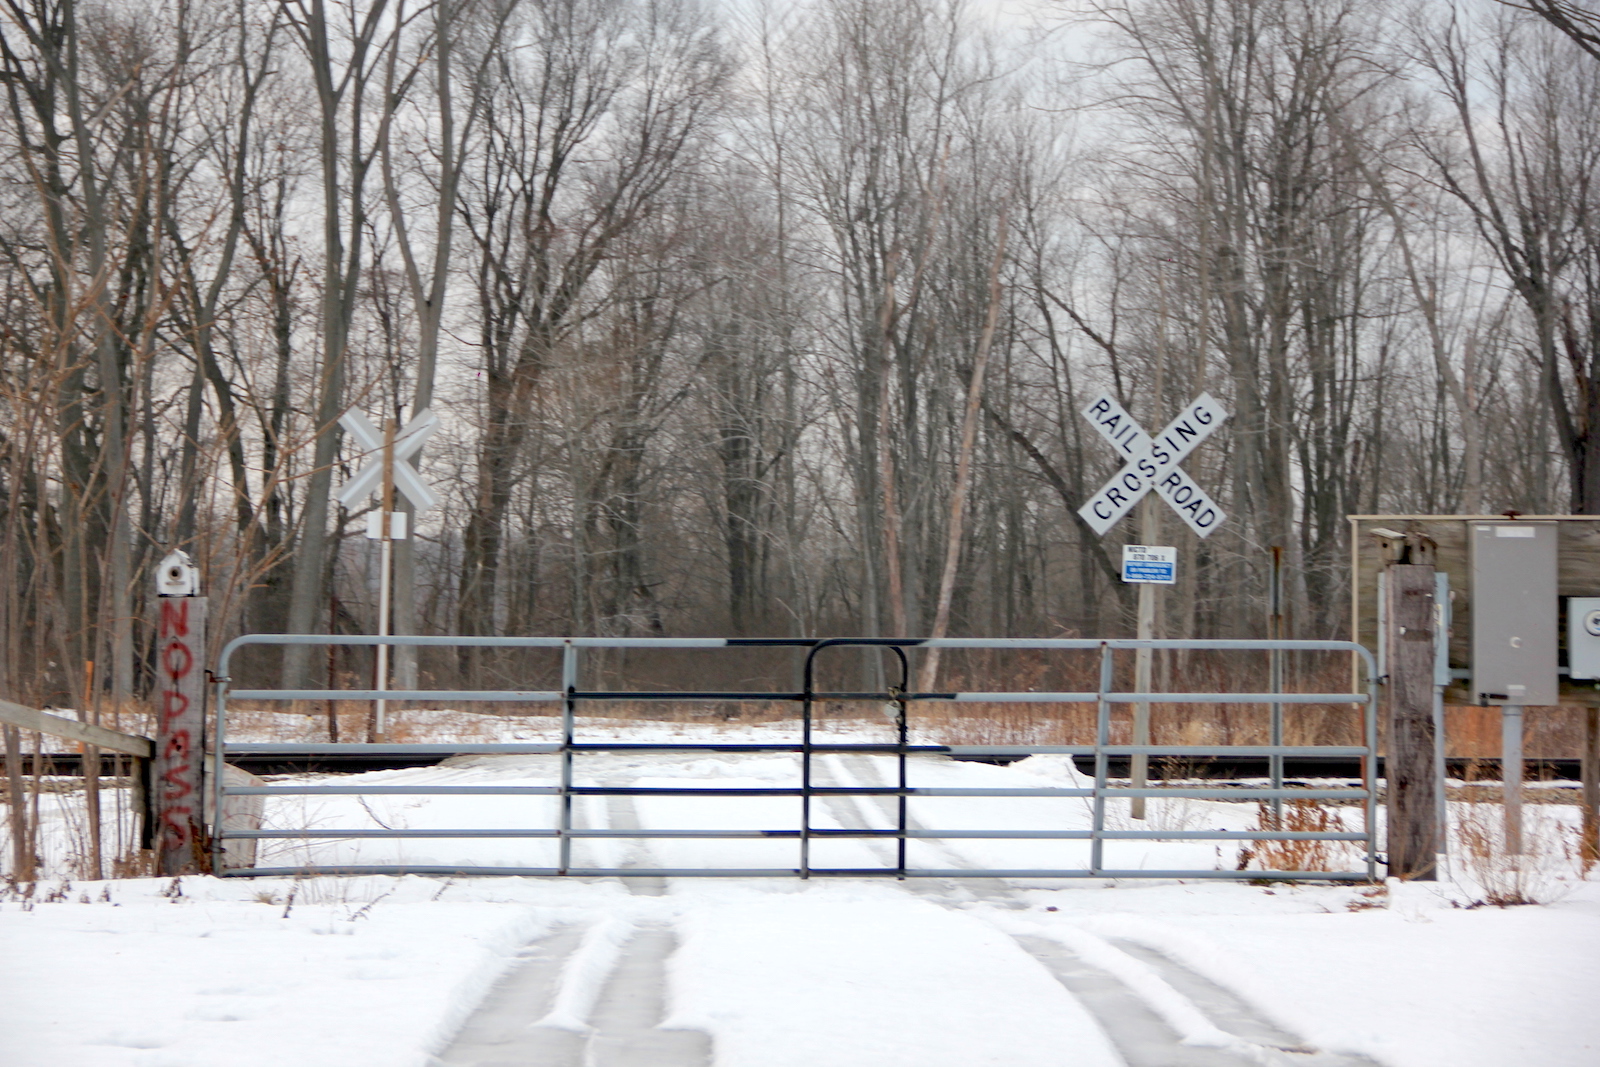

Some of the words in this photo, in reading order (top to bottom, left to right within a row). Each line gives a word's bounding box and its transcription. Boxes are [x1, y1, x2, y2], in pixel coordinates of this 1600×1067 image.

[1089, 398, 1139, 454] RAIL
[1159, 472, 1216, 528] ROAD
[1093, 406, 1213, 520] CROSSING
[161, 600, 193, 679] NO
[161, 690, 192, 850] PASS
